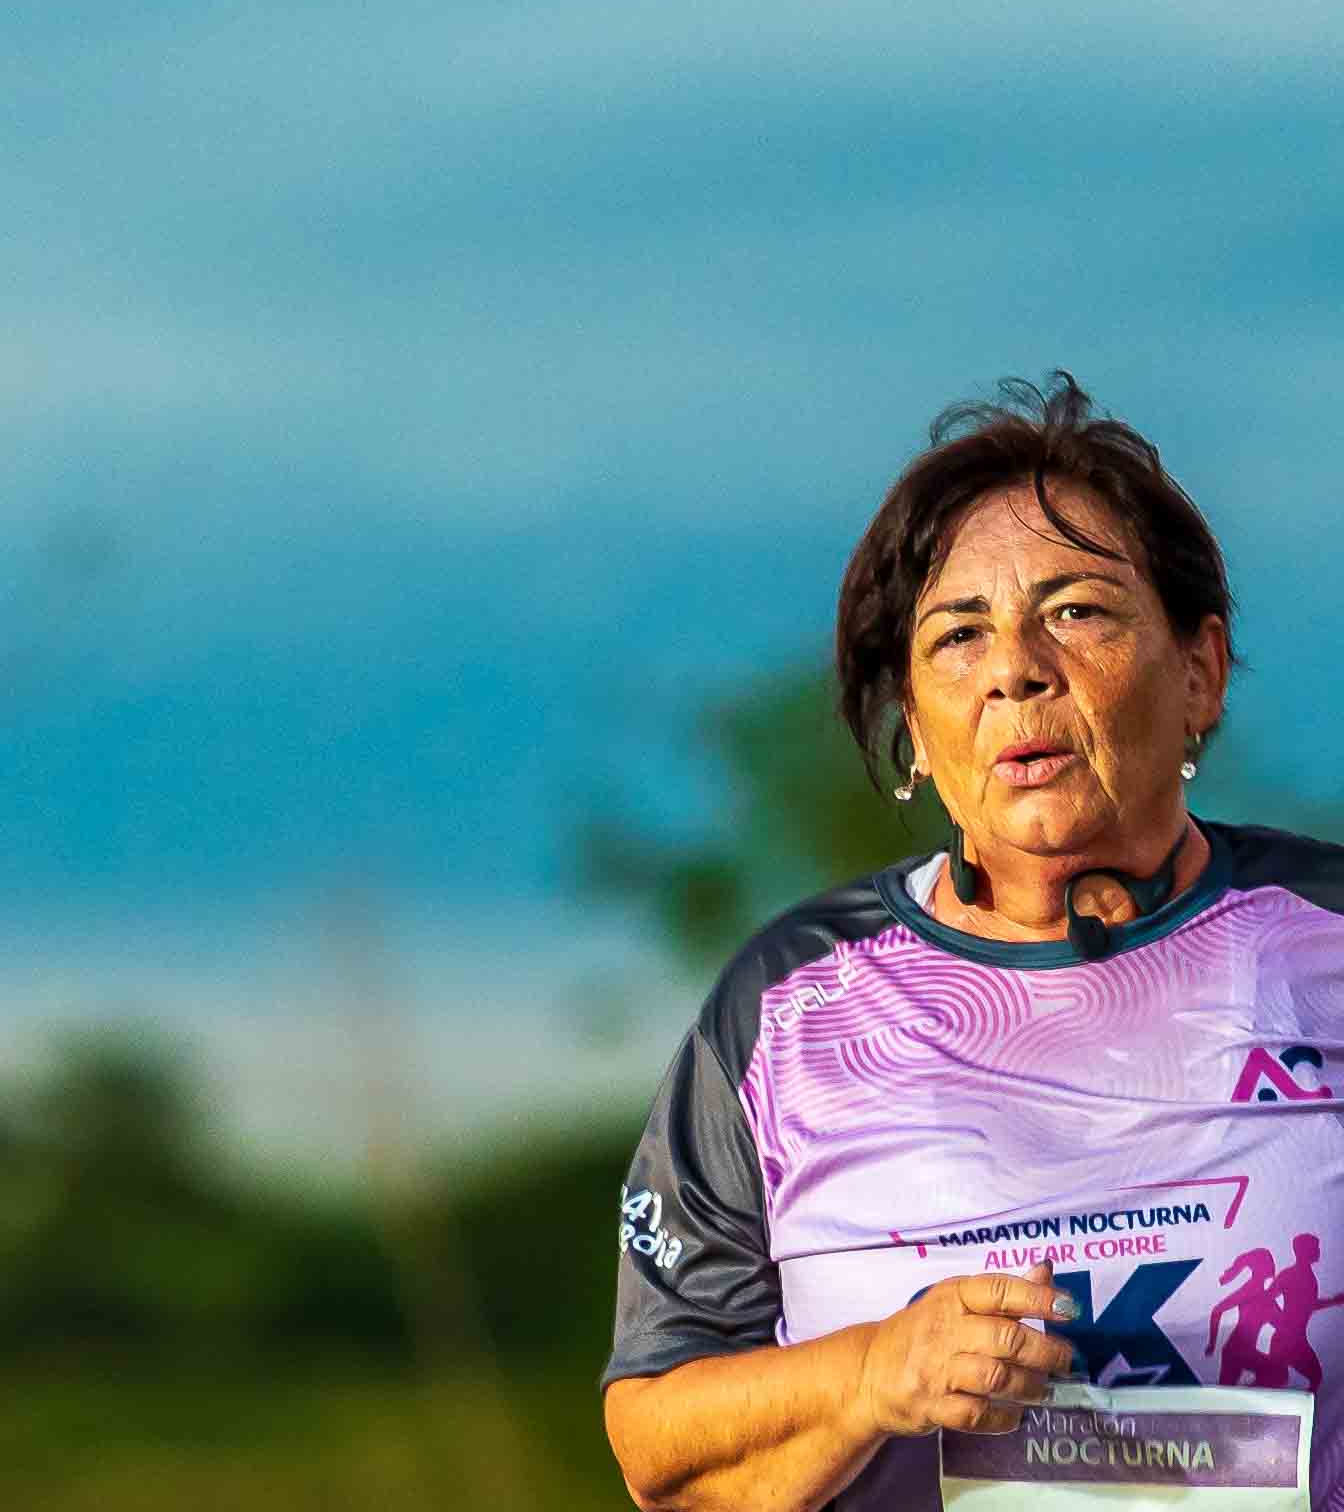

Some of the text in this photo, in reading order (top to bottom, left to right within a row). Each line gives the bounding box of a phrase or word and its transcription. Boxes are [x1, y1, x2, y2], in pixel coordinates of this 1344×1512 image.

[938, 1203, 1211, 1247] MARATON NOCTURNA
[985, 1234, 1168, 1270] ALVEAR CORRE
[907, 1258, 1204, 1386] K
[1026, 1437, 1216, 1471] NOCTURNA
